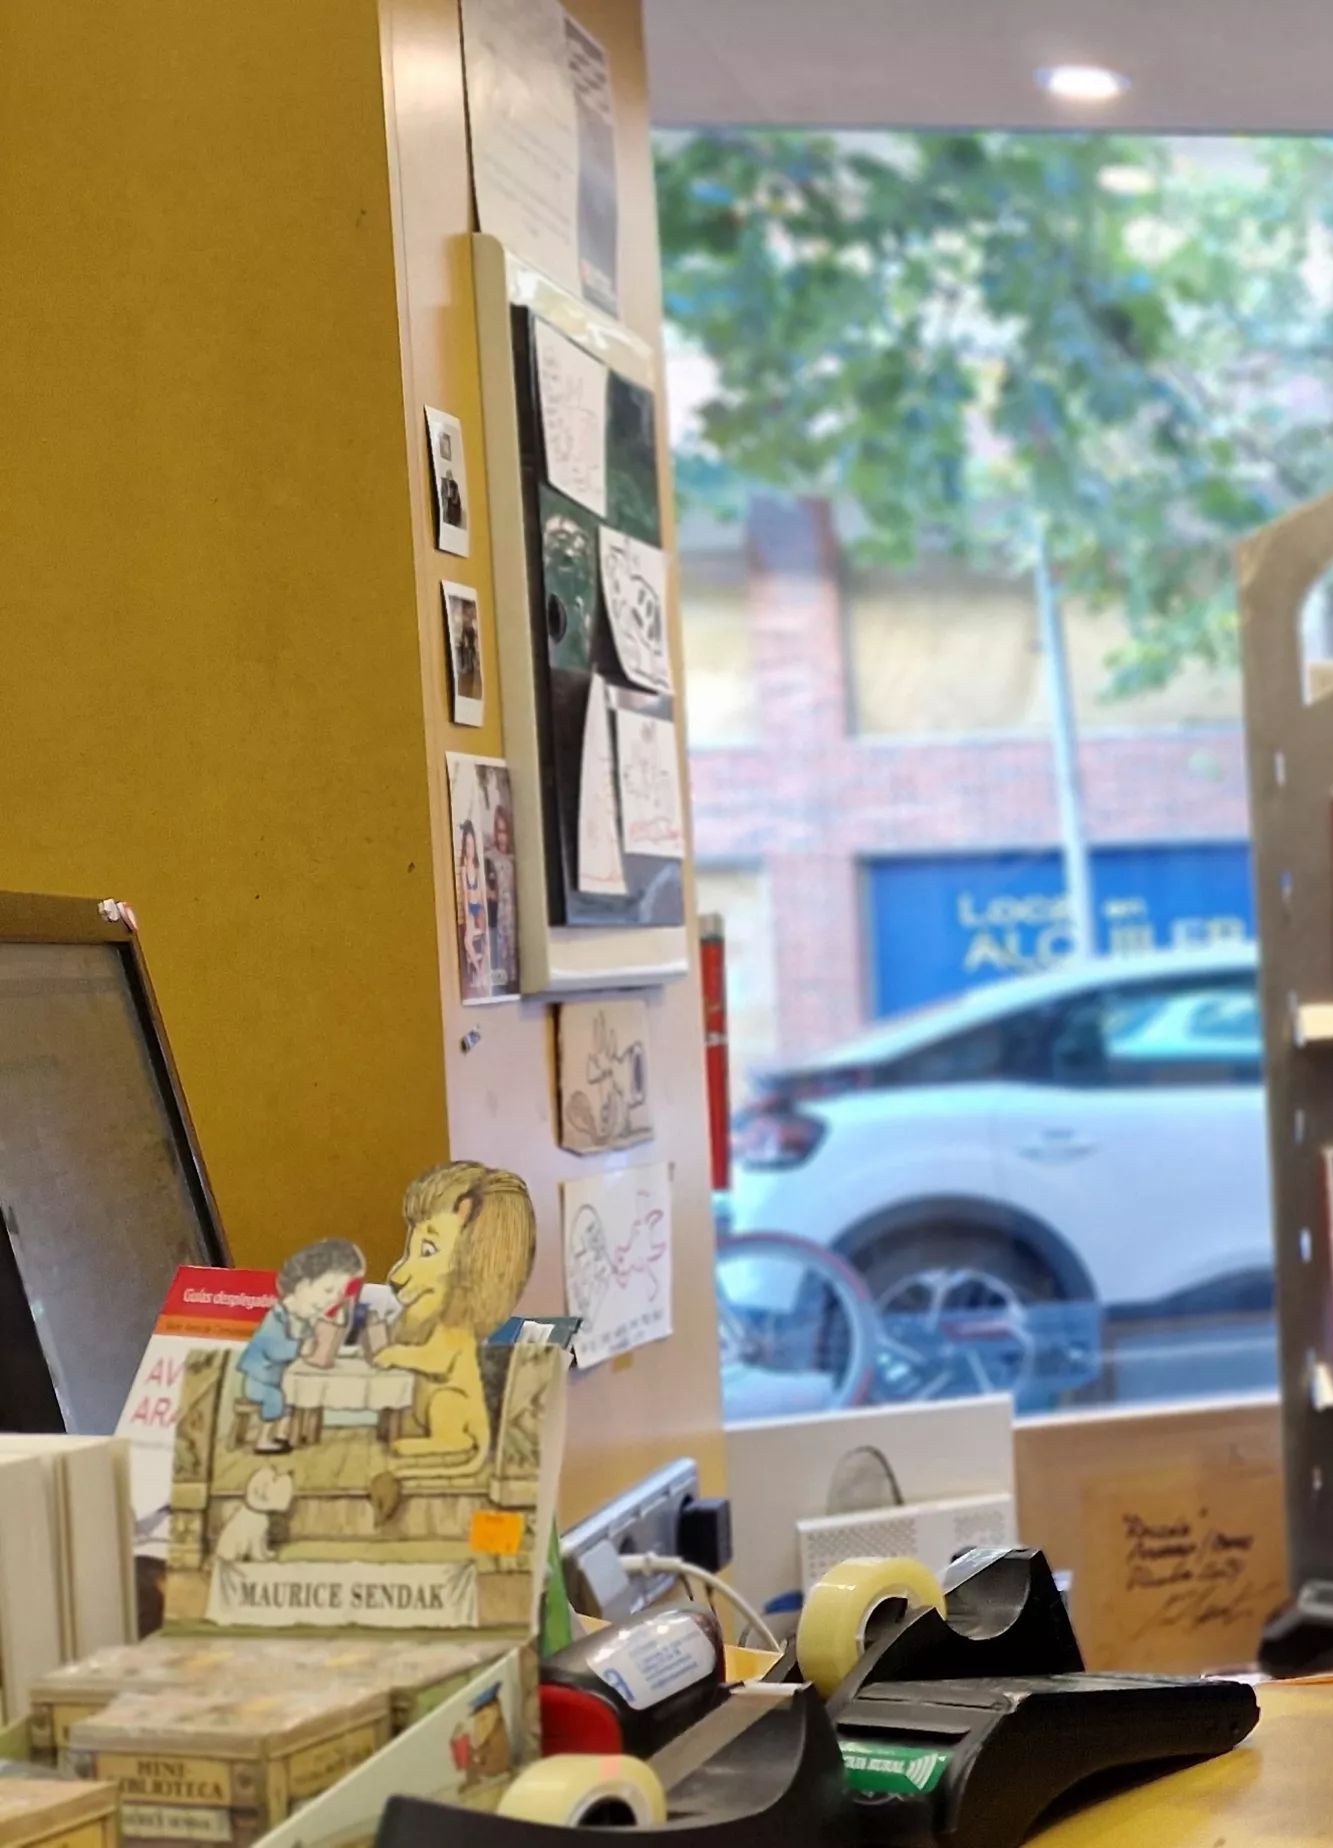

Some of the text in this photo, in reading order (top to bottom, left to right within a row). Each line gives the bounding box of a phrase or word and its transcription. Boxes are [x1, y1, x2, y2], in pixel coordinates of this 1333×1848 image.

[957, 892, 1086, 928] Loca
[239, 1581, 445, 1610] MAURICE SENDAK
[117, 1777, 225, 1800] IBLIOTECA
